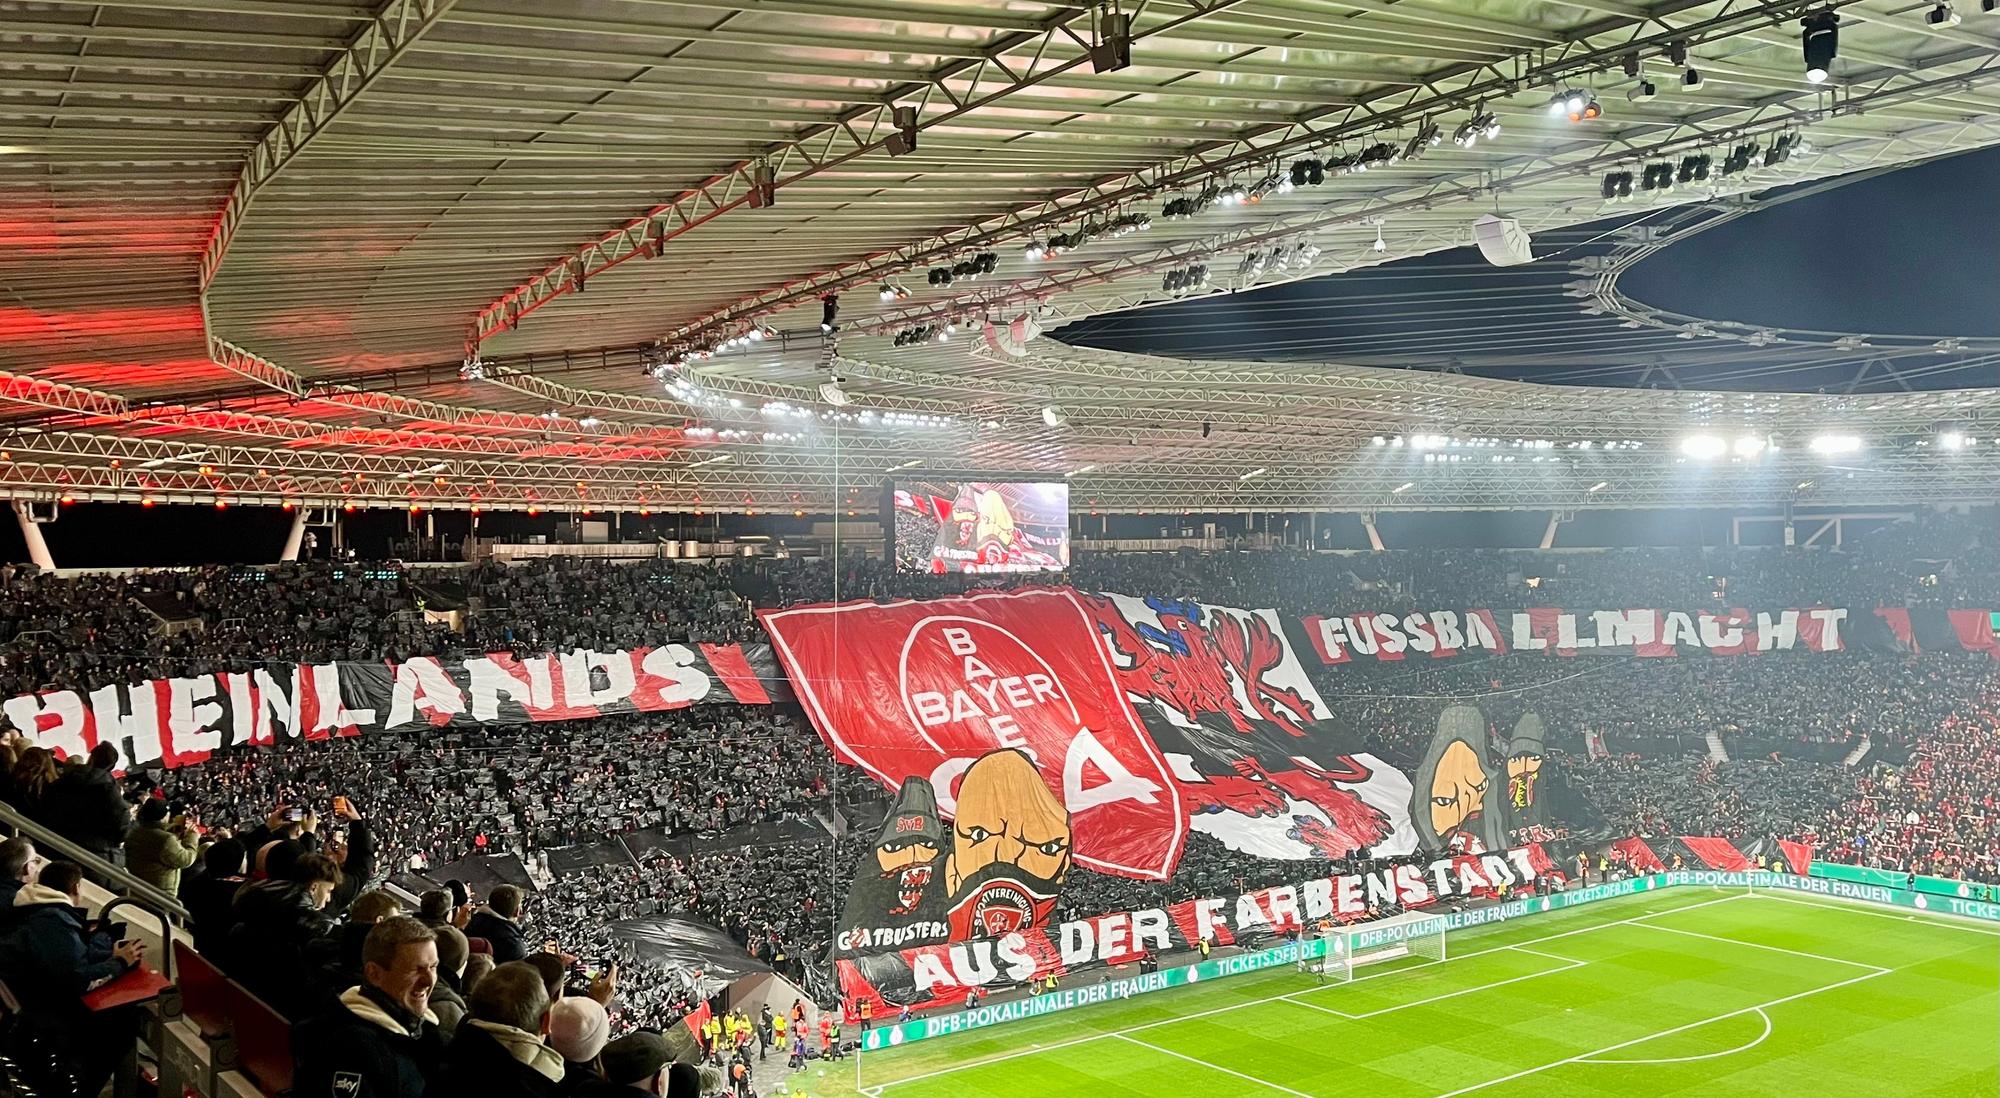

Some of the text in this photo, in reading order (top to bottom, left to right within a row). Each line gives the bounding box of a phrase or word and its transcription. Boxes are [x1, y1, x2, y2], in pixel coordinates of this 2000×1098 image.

[3, 643, 712, 770] RHEINLANDS
[912, 673, 1061, 727] BAYER
[895, 815, 924, 833] SVB
[1563, 881, 1636, 906] TICKETS.DFB.DE
[1667, 871, 1892, 903] DFB-POKALFINALE DER FRAUEN
[914, 847, 1538, 992] AUS DER FARBENSTADT
[1464, 910, 1485, 926] DER
[1487, 901, 1528, 922] FRAUEN
[1216, 942, 1318, 976] TICKETS.DFBDE
[927, 974, 1169, 1037] DFB-POKALFINALE DER FRAUEN
[335, 1077, 357, 1093] sky
